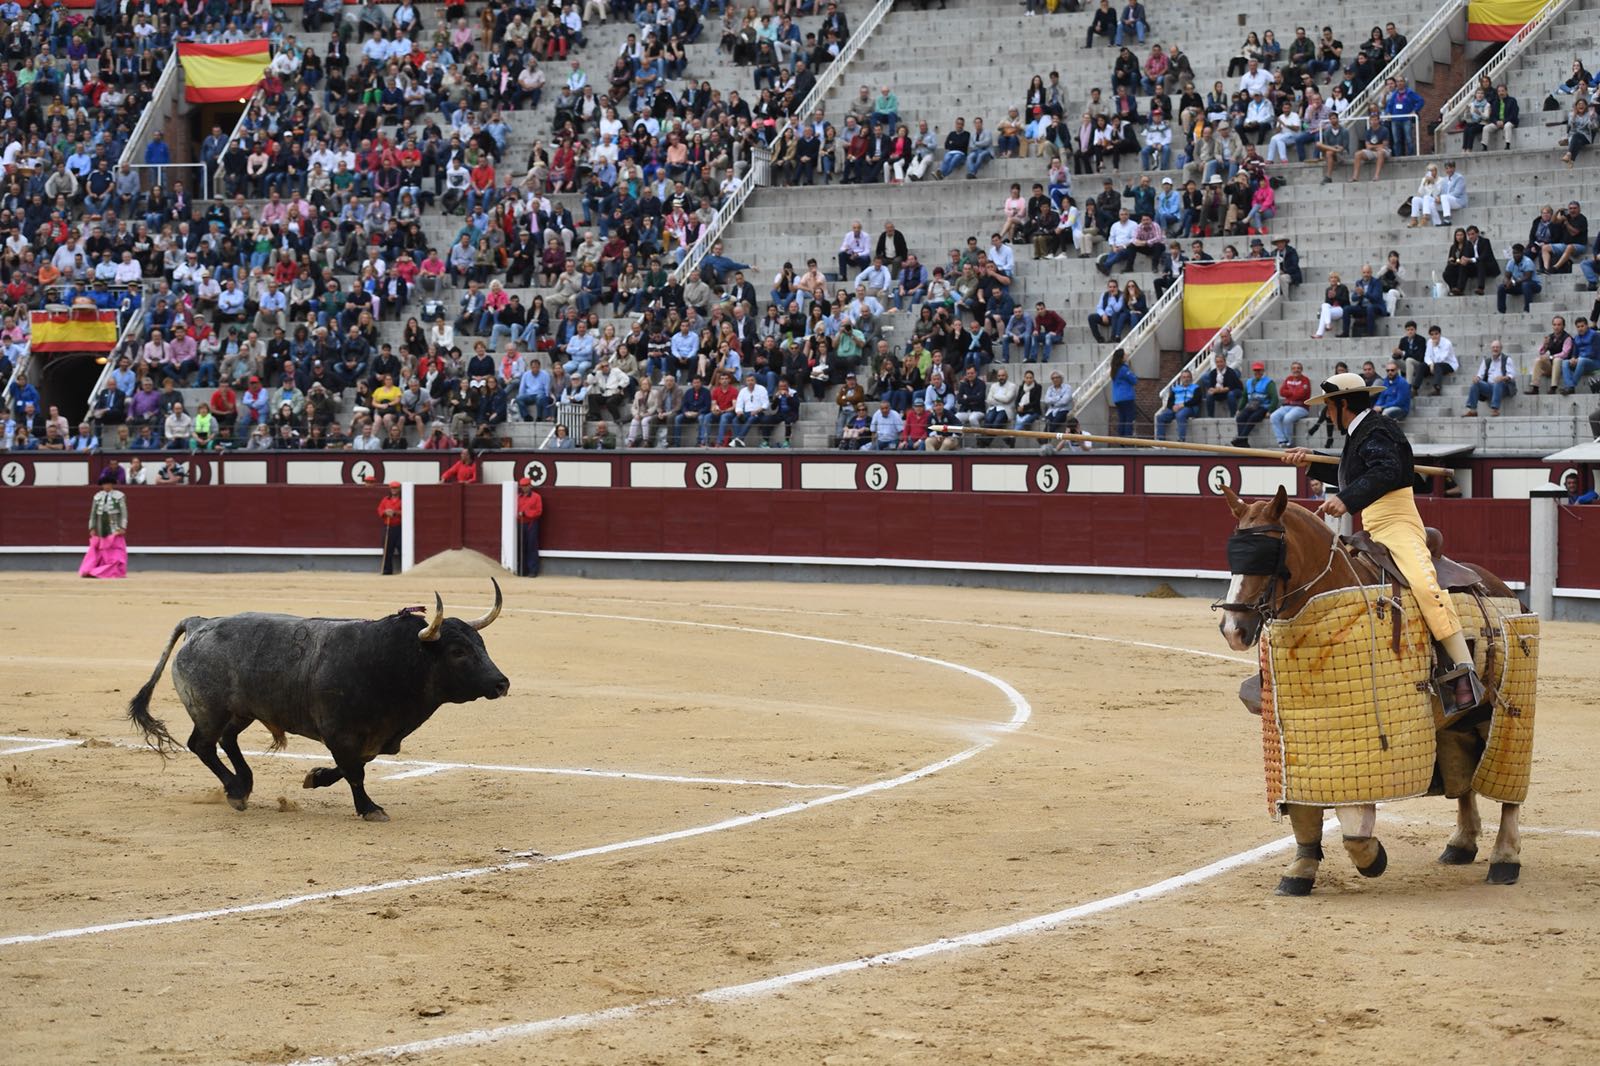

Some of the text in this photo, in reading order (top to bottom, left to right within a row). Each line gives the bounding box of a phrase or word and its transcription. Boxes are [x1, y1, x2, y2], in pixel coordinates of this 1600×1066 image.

[8, 466, 17, 483] 4
[357, 465, 367, 482] 4
[701, 466, 712, 485] 5
[871, 467, 882, 487] 5
[1043, 468, 1053, 489] 5
[1215, 470, 1225, 491] 5
